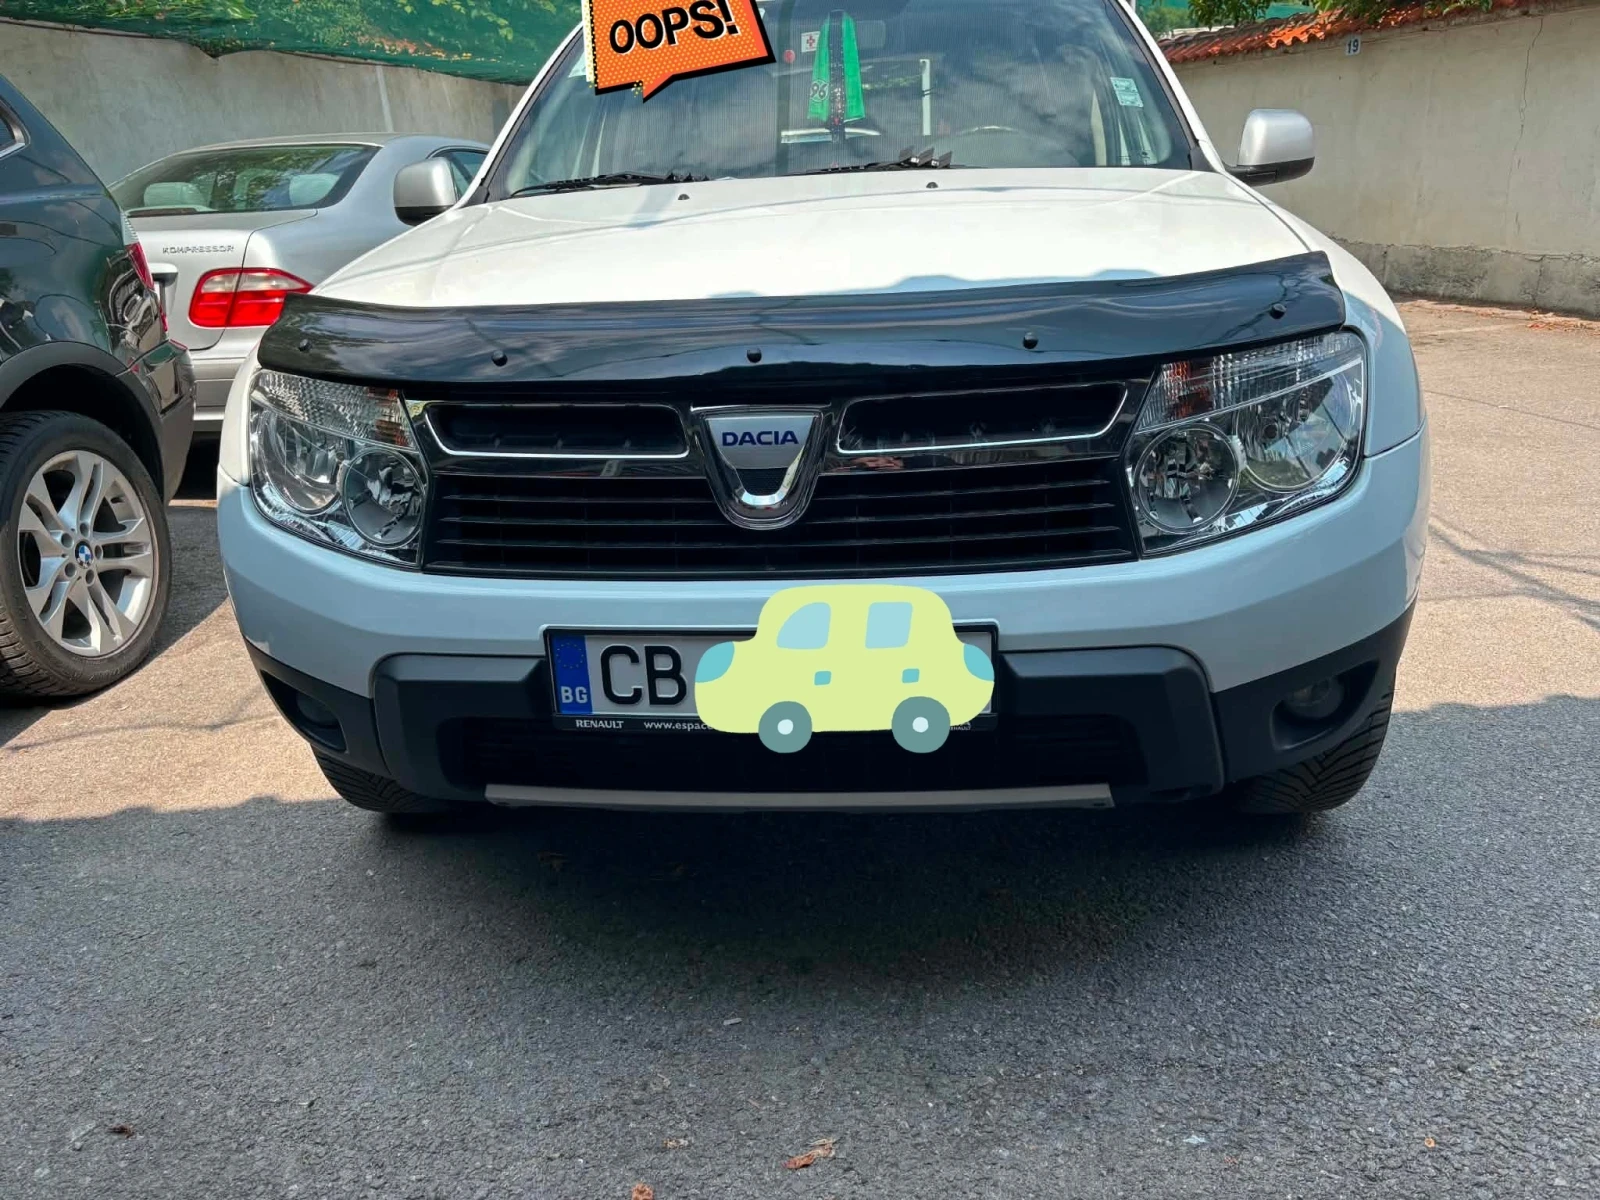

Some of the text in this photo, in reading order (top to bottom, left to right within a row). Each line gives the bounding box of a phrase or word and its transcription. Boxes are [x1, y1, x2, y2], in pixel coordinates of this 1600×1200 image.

[1347, 39, 1359, 54] 19
[162, 245, 234, 254] KOMPRESSOR
[721, 430, 799, 446] DACIA
[600, 644, 687, 705] CB
[560, 686, 588, 703] BG
[575, 719, 624, 729] RENAULT
